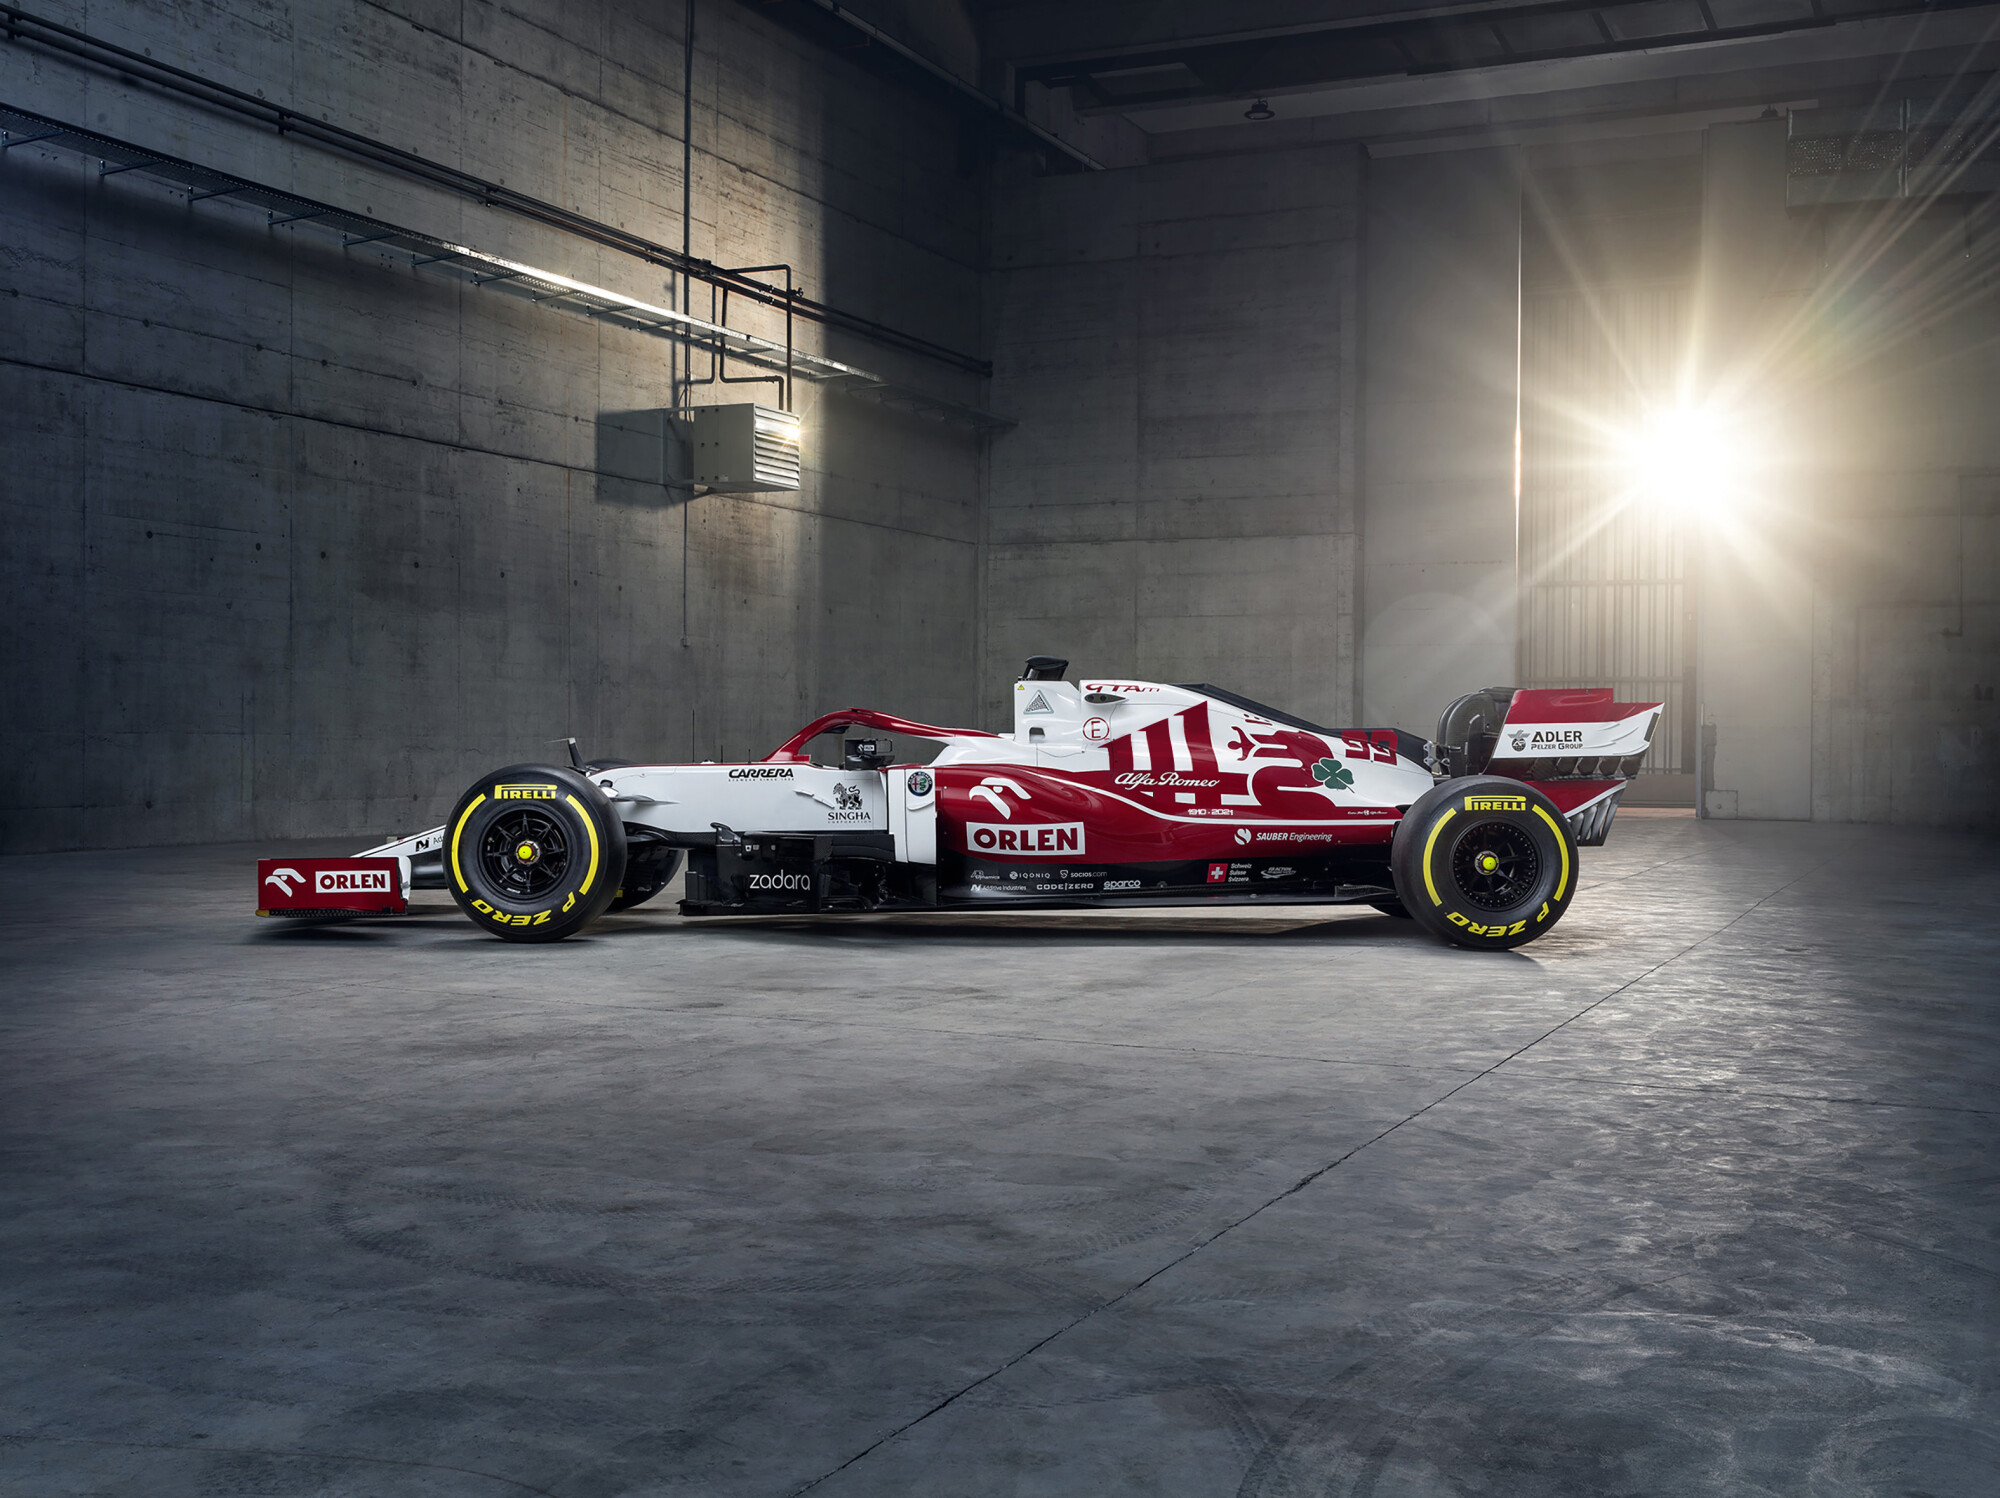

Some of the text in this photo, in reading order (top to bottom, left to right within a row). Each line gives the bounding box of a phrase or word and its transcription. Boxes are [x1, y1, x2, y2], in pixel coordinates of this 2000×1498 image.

[1532, 731, 1583, 742] ADLER
[728, 768, 794, 778] CARRERA
[1114, 772, 1220, 790] Alfa Romeo
[494, 784, 558, 799] PIRELLI
[1464, 795, 1526, 811] PIRELLI
[827, 811, 871, 820] SINGHA
[973, 827, 1078, 851] ORLEN
[1256, 832, 1333, 842] SAUBER Engineering
[319, 873, 386, 889] ORLEN
[749, 869, 811, 891] zadara
[1103, 880, 1141, 890] sparco
[471, 891, 576, 926] P ZERO
[1446, 901, 1550, 937] P ZERO
